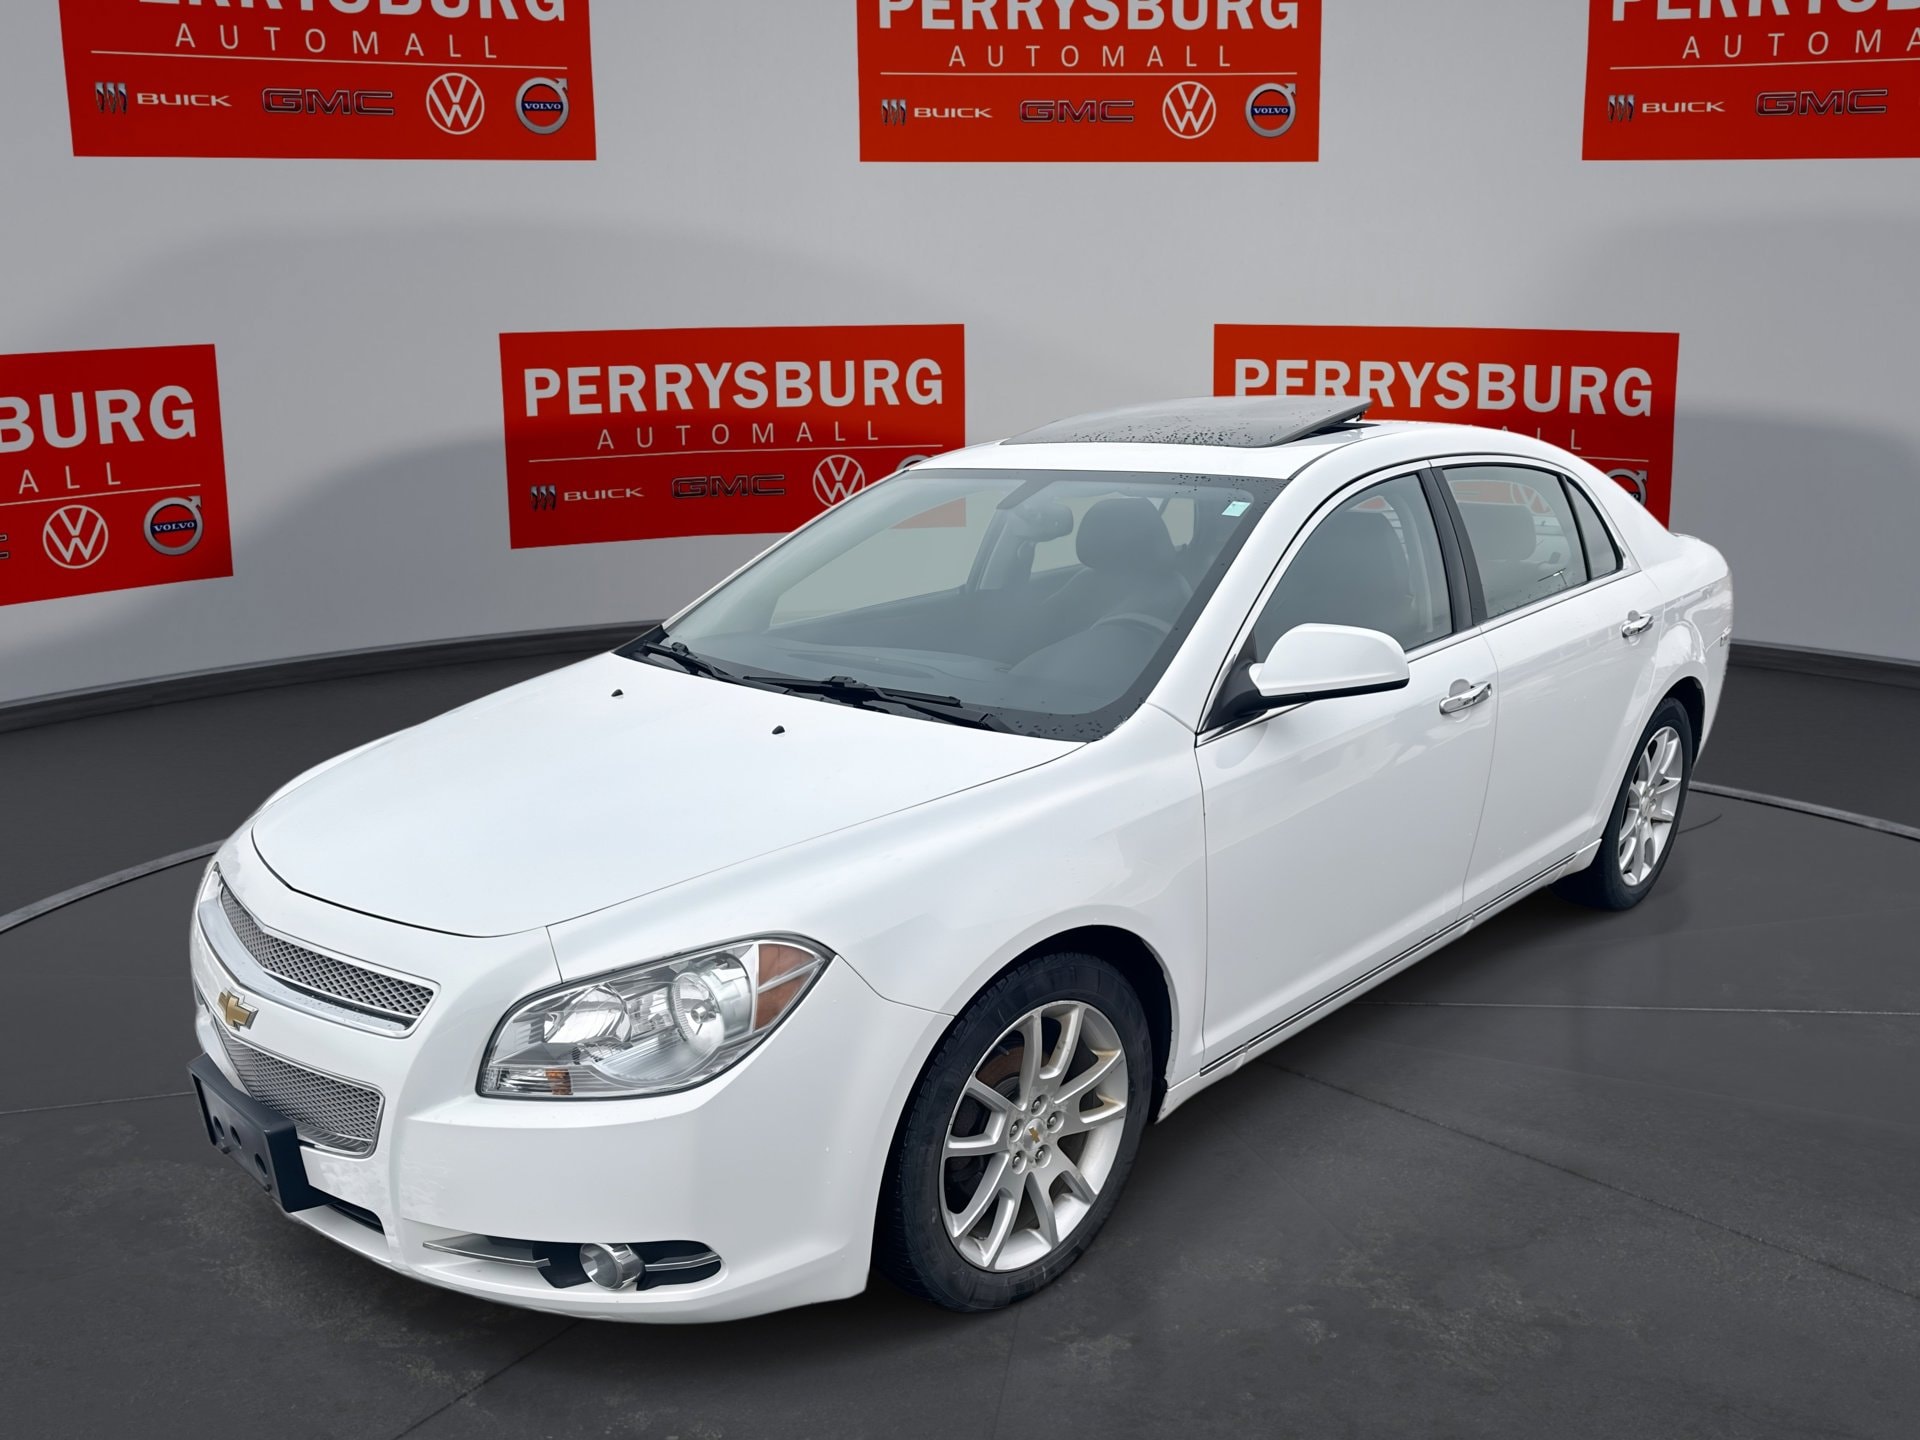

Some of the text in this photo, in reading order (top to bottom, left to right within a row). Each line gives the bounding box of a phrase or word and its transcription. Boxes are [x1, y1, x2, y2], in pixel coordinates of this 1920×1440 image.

[878, 0, 1298, 30] PERRYSBURG
[175, 23, 497, 59] AUTOMALL
[949, 45, 1231, 67] AUTOMALL
[136, 92, 232, 107] BUICK
[262, 87, 395, 116] GMC
[524, 102, 562, 112] VOLVO
[1253, 106, 1289, 116] VOLVO
[1641, 101, 1725, 113] BUICK
[1755, 88, 1888, 116] GMC
[914, 107, 993, 119] BUICK
[1019, 100, 1135, 123] GMC
[525, 358, 943, 417] PERRYSBURG
[1234, 358, 1653, 417] PERRYSBURG
[597, 421, 879, 450] AUTOMALL
[564, 487, 644, 501] BUICK
[671, 473, 786, 499] GMC
[153, 520, 196, 533] VOLVO
